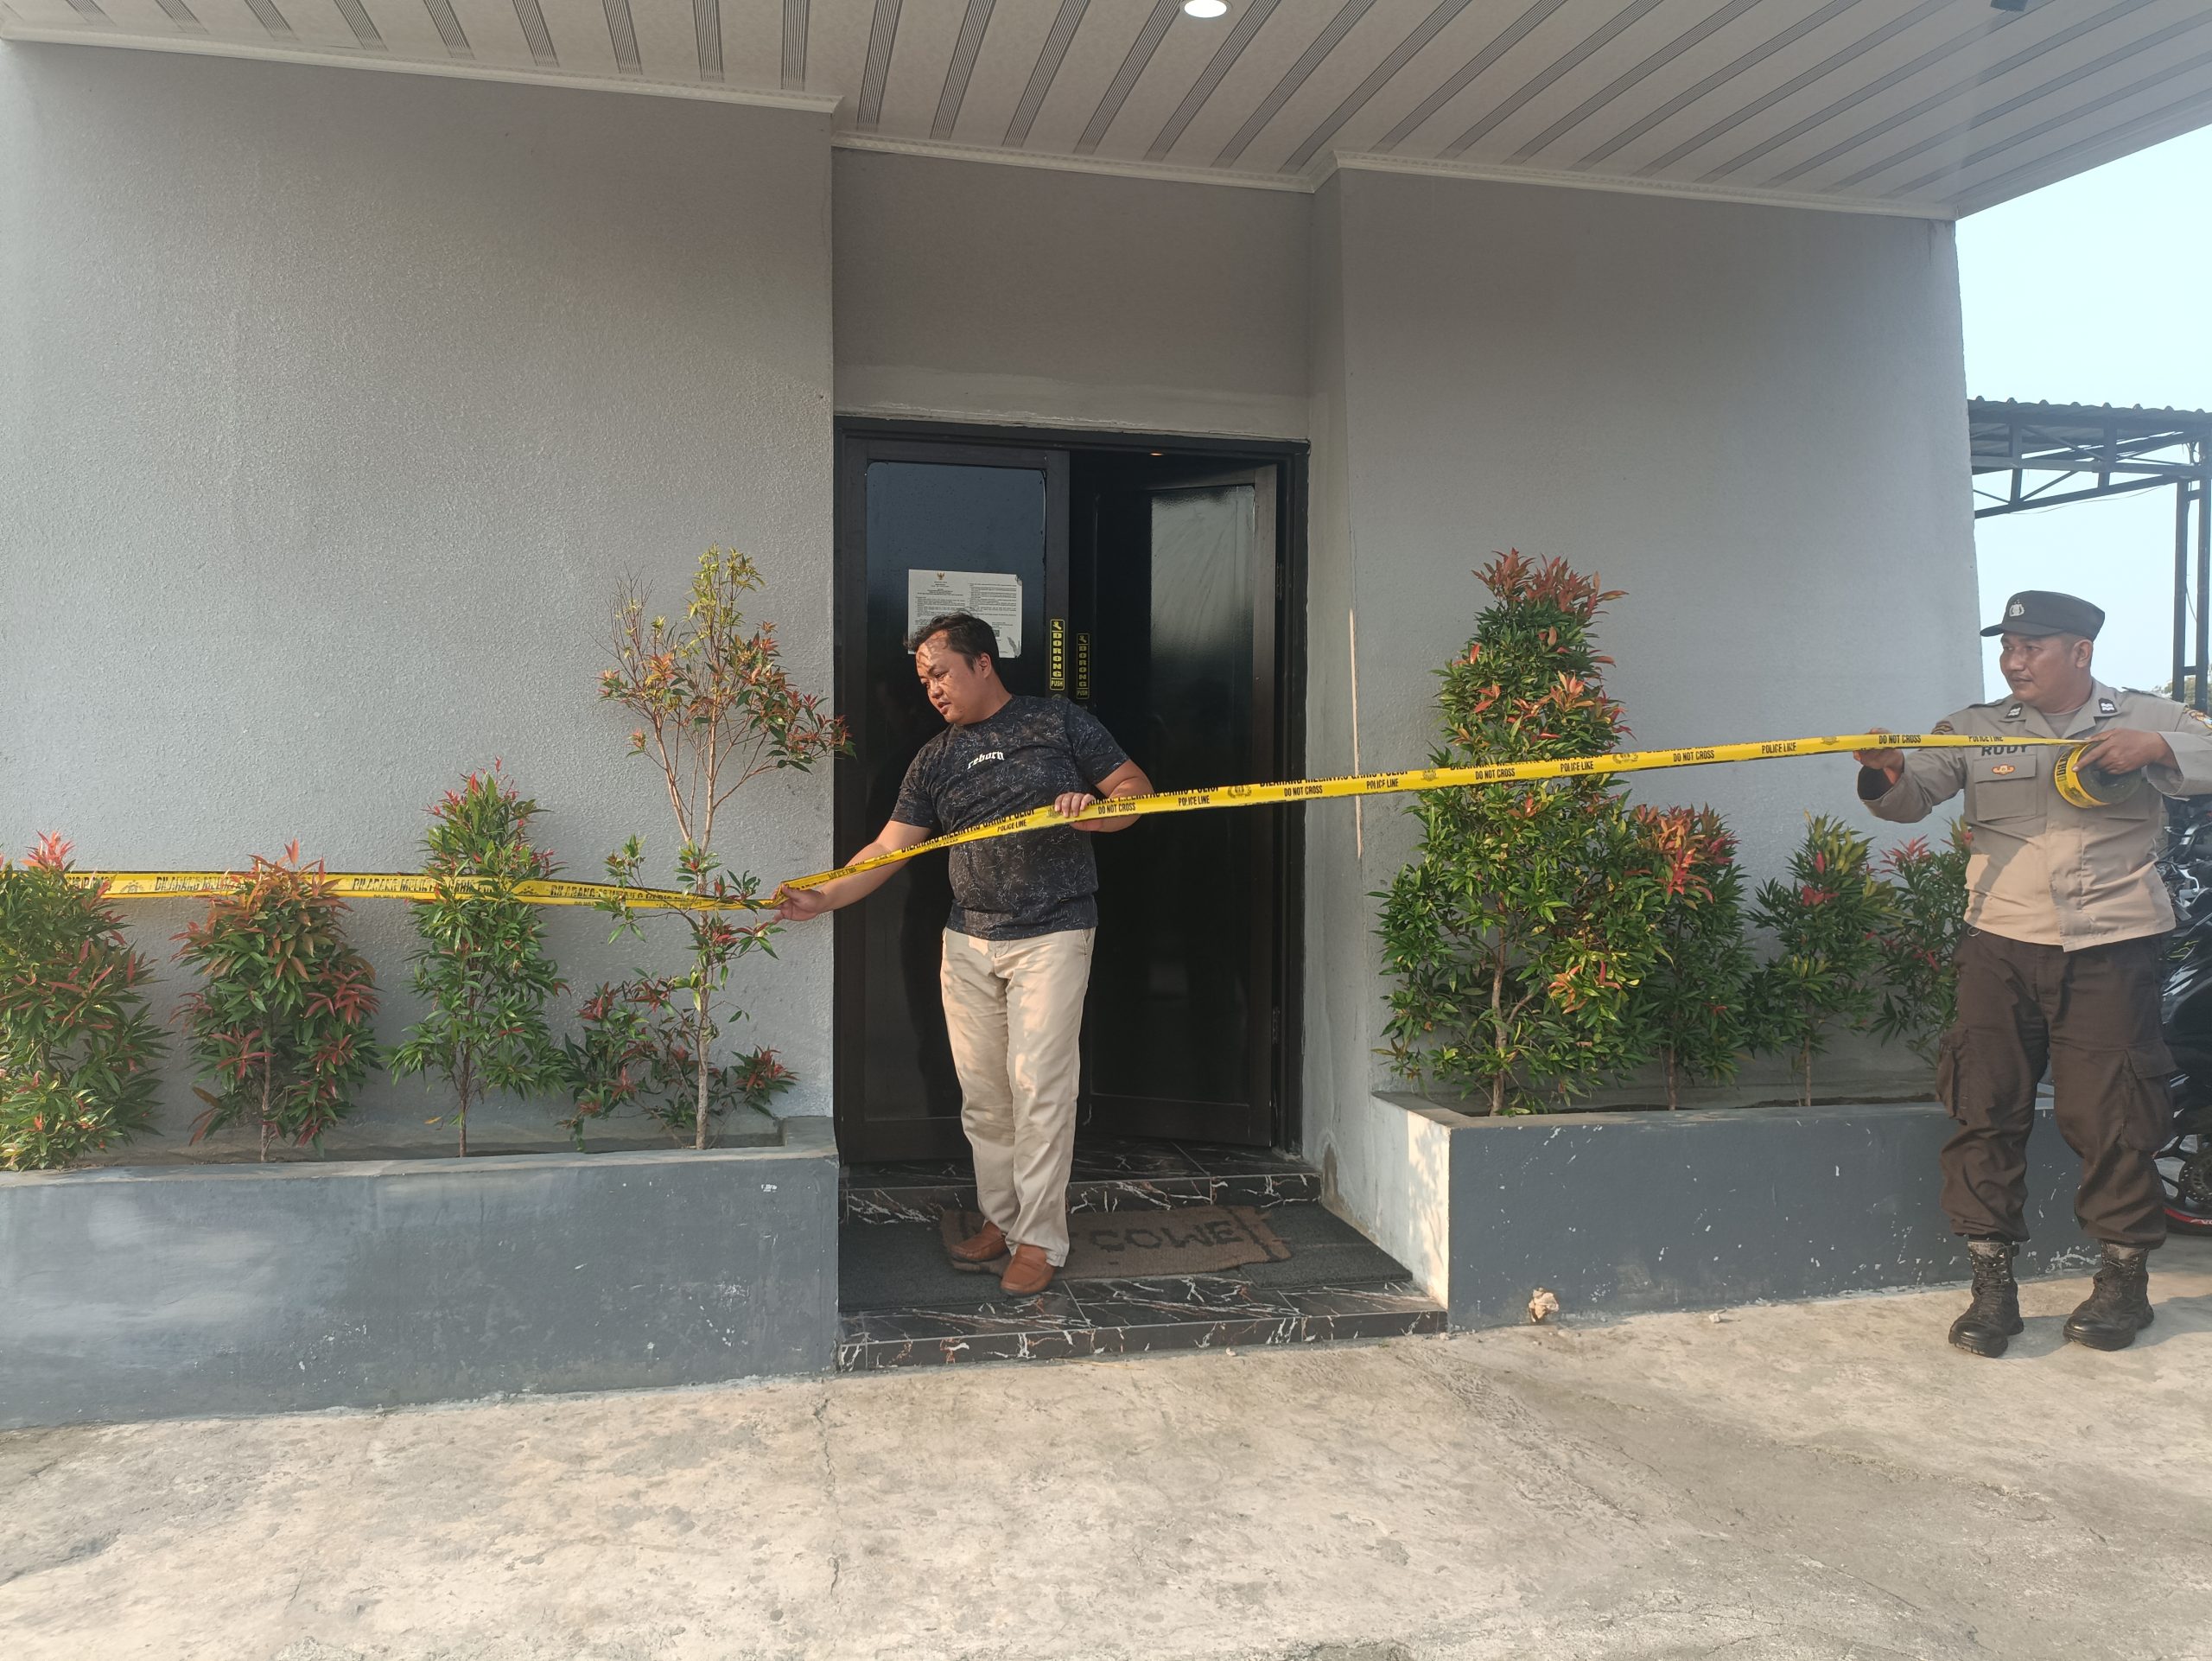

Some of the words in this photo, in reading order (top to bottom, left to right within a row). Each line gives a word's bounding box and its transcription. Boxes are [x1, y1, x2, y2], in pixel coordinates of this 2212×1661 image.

[1052, 633, 1062, 678] DORONG
[1078, 646, 1087, 687] DORONG
[1878, 735, 1887, 744] DO
[1888, 735, 1900, 743] NOT
[1902, 735, 1922, 743] CROSS
[967, 751, 1005, 770] reborn
[1673, 753, 1681, 762] DO
[1682, 751, 1694, 761] NOT
[1695, 750, 1715, 760] CROSS
[1475, 770, 1484, 780] DO
[1484, 769, 1496, 779] NOT
[1497, 767, 1516, 778] CROSS
[1284, 787, 1293, 797] DO
[1293, 786, 1304, 796] NOT
[1305, 785, 1323, 794] CROSS
[1097, 805, 1106, 815] DO
[1107, 805, 1117, 813] NOT
[1118, 802, 1136, 811] CROSS
